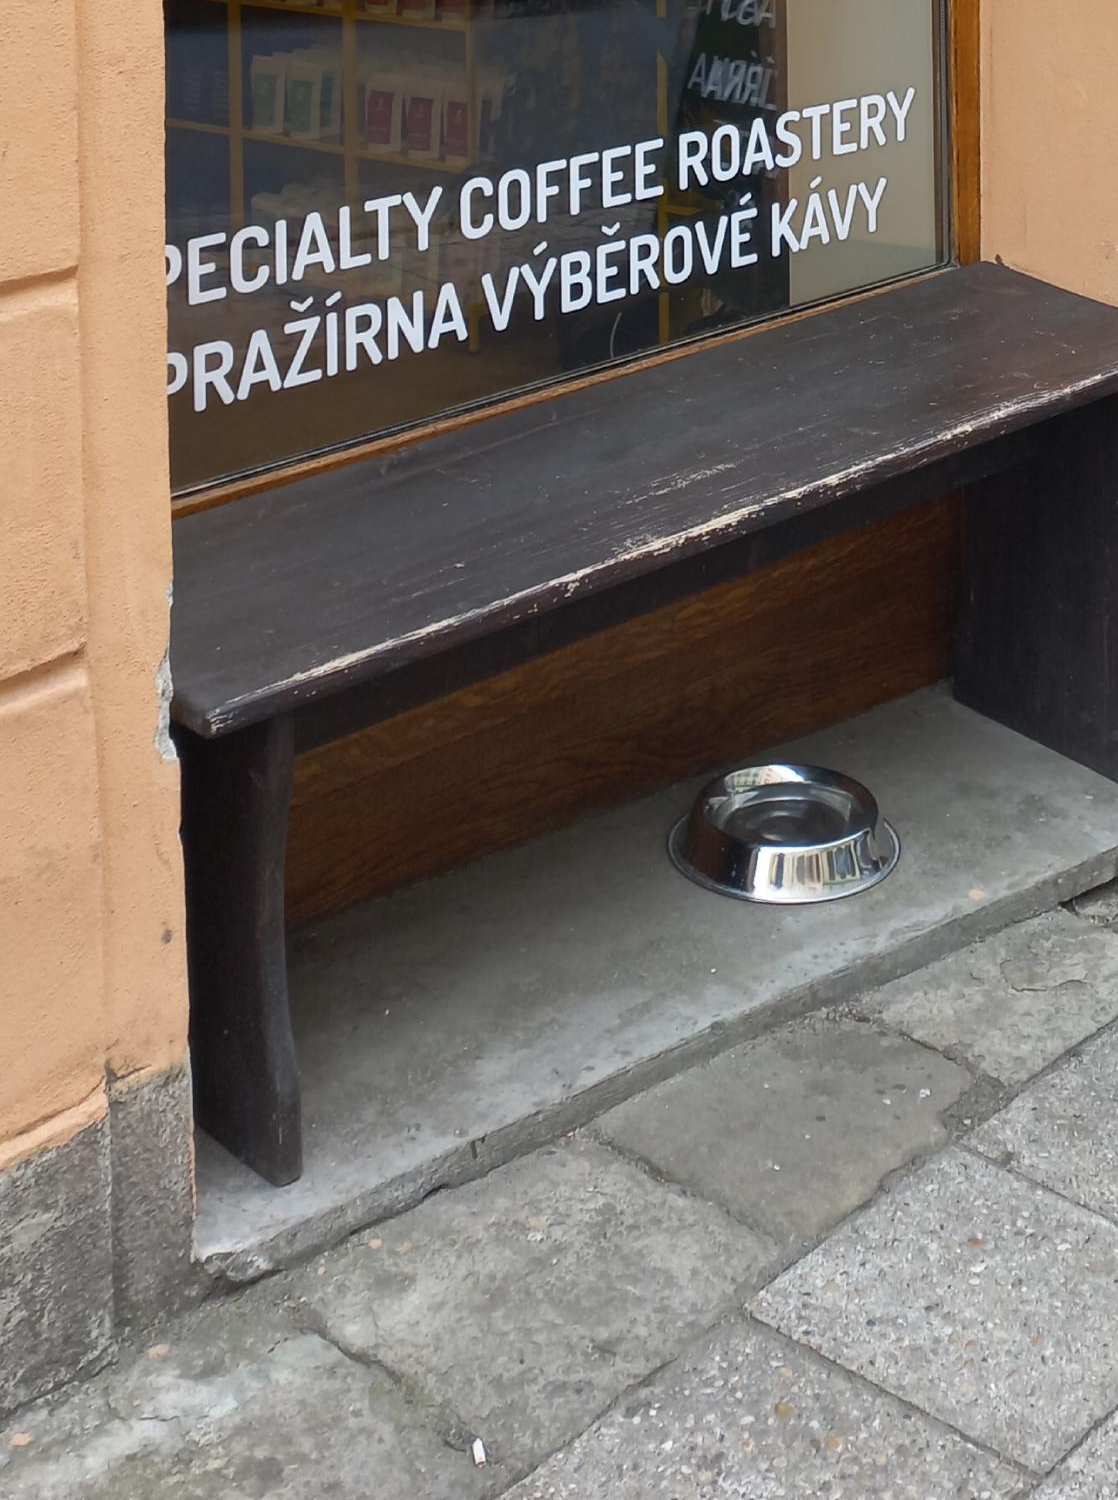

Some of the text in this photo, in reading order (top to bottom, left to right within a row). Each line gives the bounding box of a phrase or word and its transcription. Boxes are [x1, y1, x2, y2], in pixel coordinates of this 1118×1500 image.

[164, 86, 917, 306] PECIALTY COFFEE ROASTERY
[166, 175, 888, 412] PRAŽÍRNA VÝBĚROVÉ KÁVY
